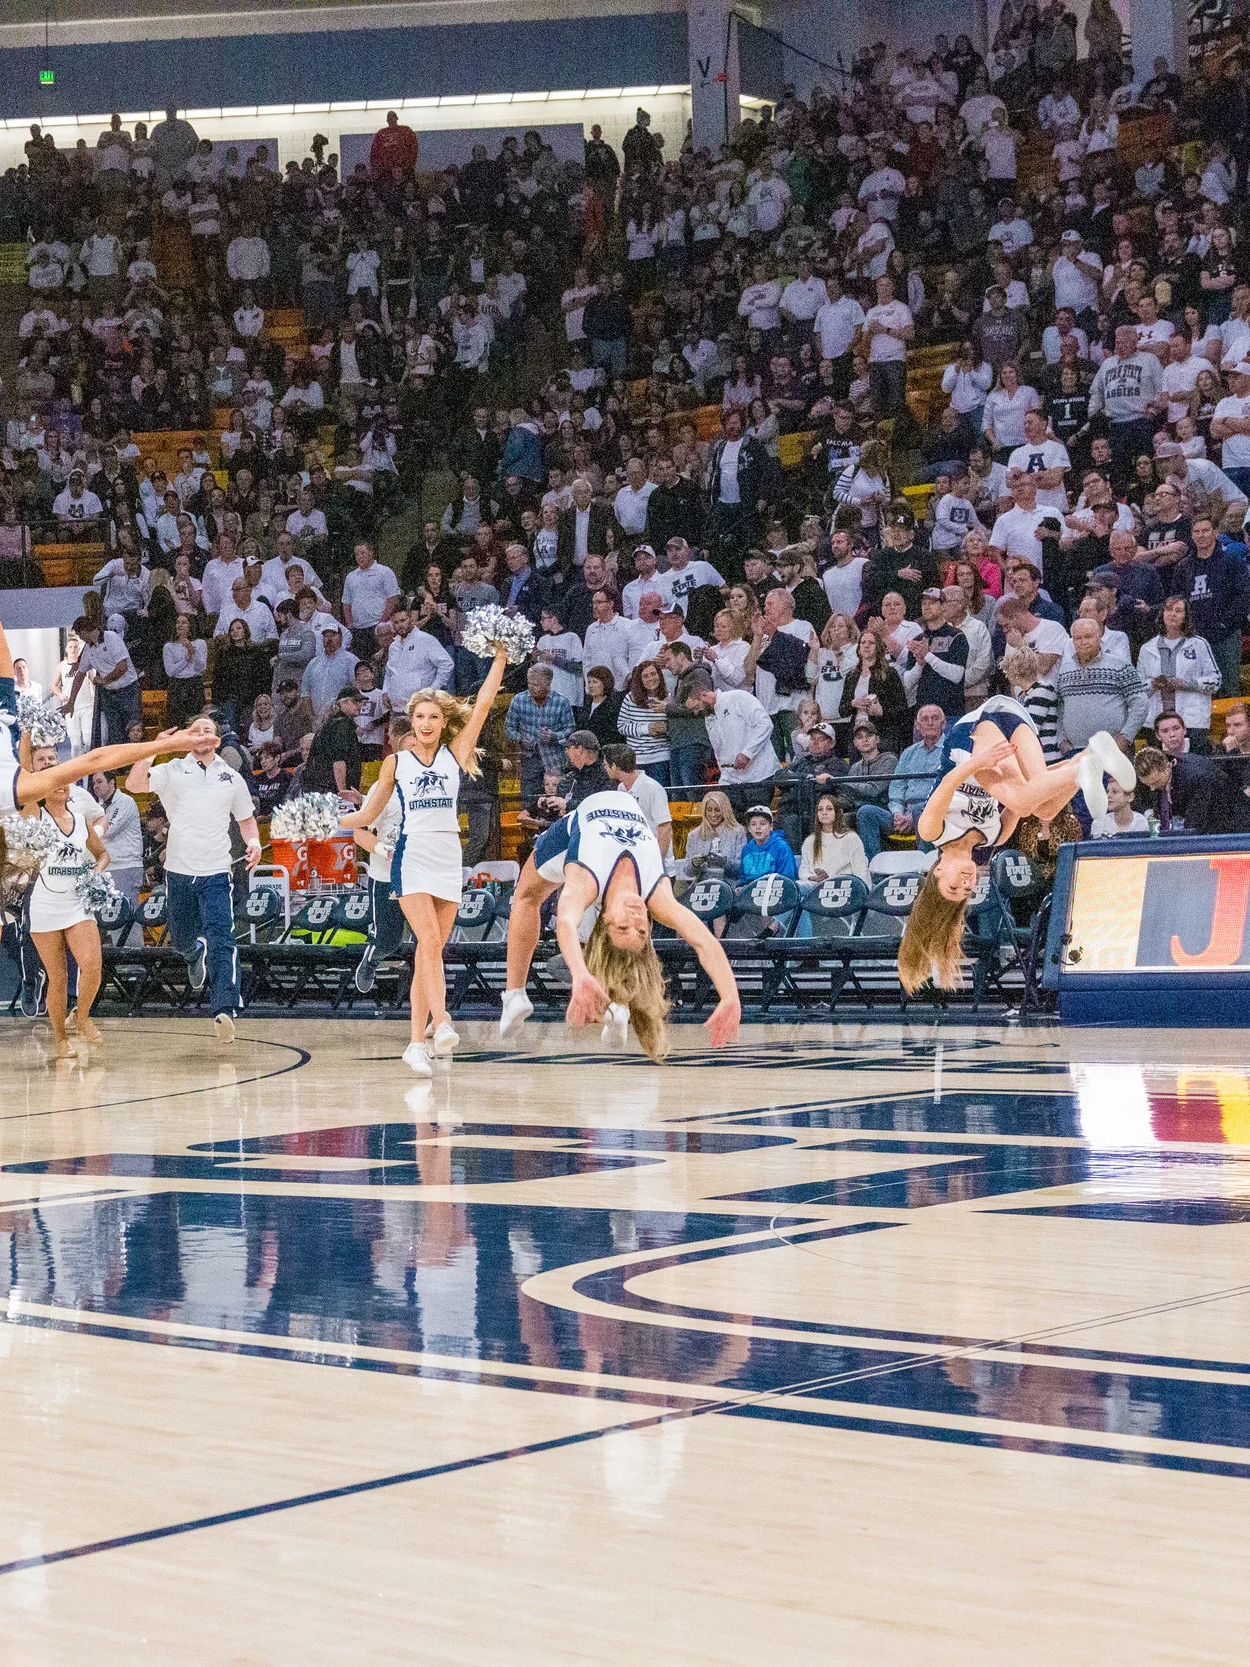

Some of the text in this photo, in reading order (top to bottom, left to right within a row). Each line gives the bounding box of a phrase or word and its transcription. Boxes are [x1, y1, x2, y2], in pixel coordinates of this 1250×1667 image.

[698, 57, 711, 78] V
[1106, 386, 1141, 399] AGGIES
[1064, 403, 1071, 419] 1
[1027, 453, 1047, 473] A
[671, 578, 697, 595] STATE
[1191, 574, 1209, 595] A
[821, 664, 840, 673] STAT
[409, 797, 453, 810] UTAH STATE
[586, 808, 620, 823] STATE
[297, 846, 308, 861] G
[343, 845, 355, 860] G
[48, 867, 68, 876] UTAH
